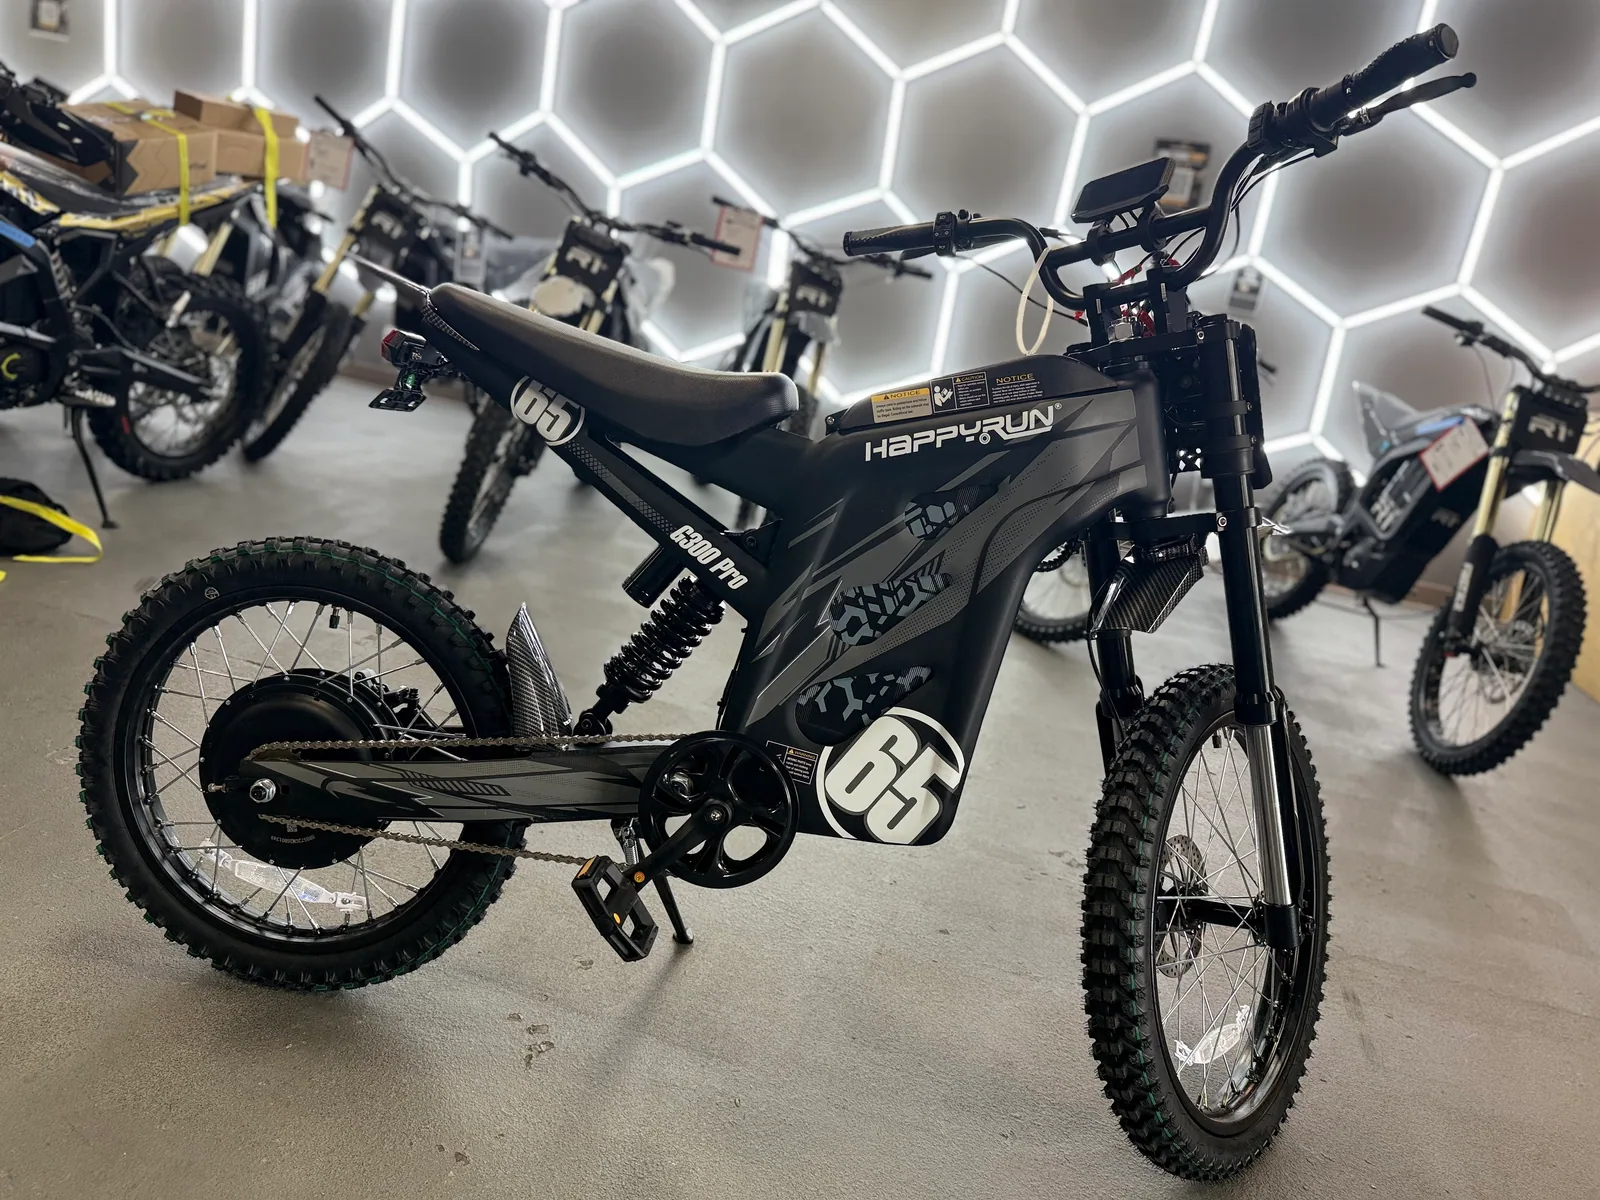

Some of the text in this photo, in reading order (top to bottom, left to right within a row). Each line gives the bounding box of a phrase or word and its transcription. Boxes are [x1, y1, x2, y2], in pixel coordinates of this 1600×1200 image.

[890, 390, 921, 399] NOTICE
[996, 373, 1034, 384] NOTICE
[513, 379, 581, 441] 65
[669, 525, 749, 590] G300 Pro
[824, 714, 963, 845] 65
